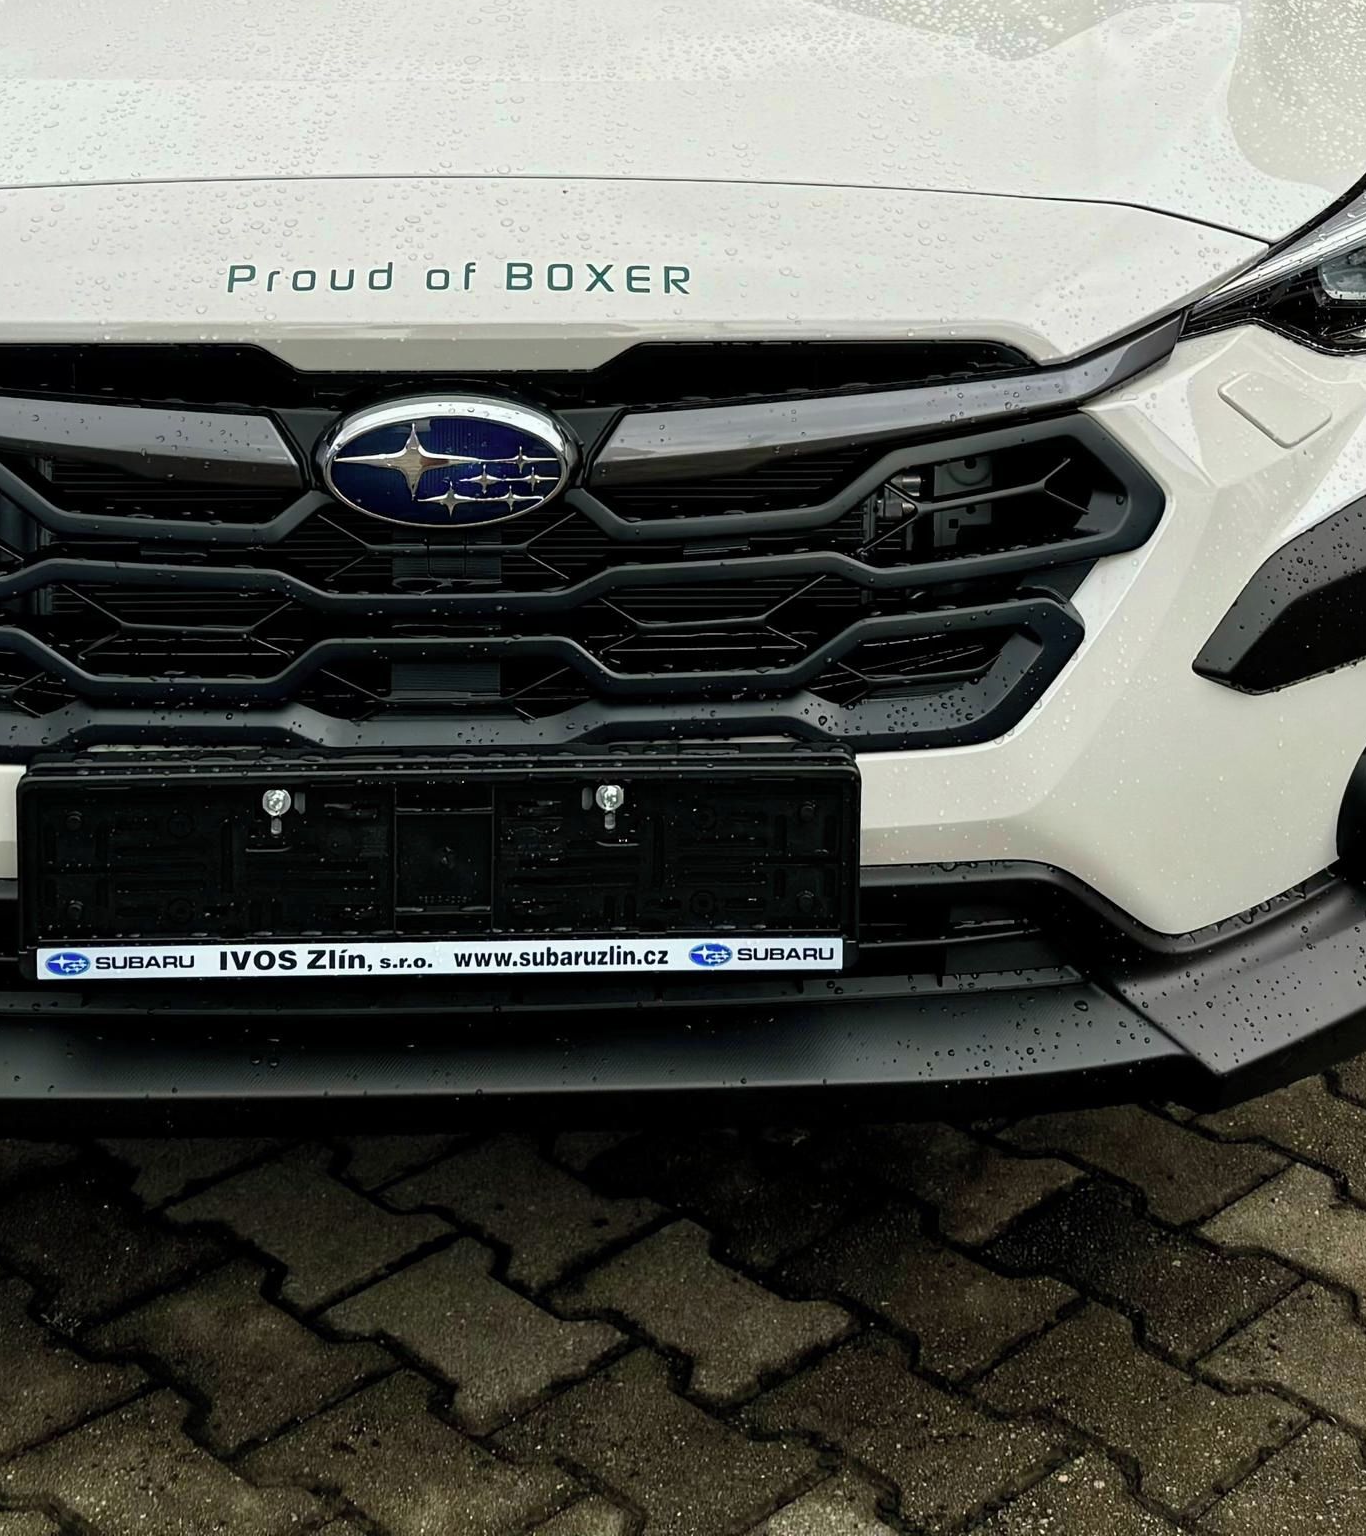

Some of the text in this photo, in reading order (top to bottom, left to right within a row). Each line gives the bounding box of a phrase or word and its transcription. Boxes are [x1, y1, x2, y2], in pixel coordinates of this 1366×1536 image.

[227, 261, 691, 295] Proud of BOXER
[95, 946, 834, 972] SUBARU IVOS Zlín, s.r.o. www.subaruzlin.cz SUBARU
